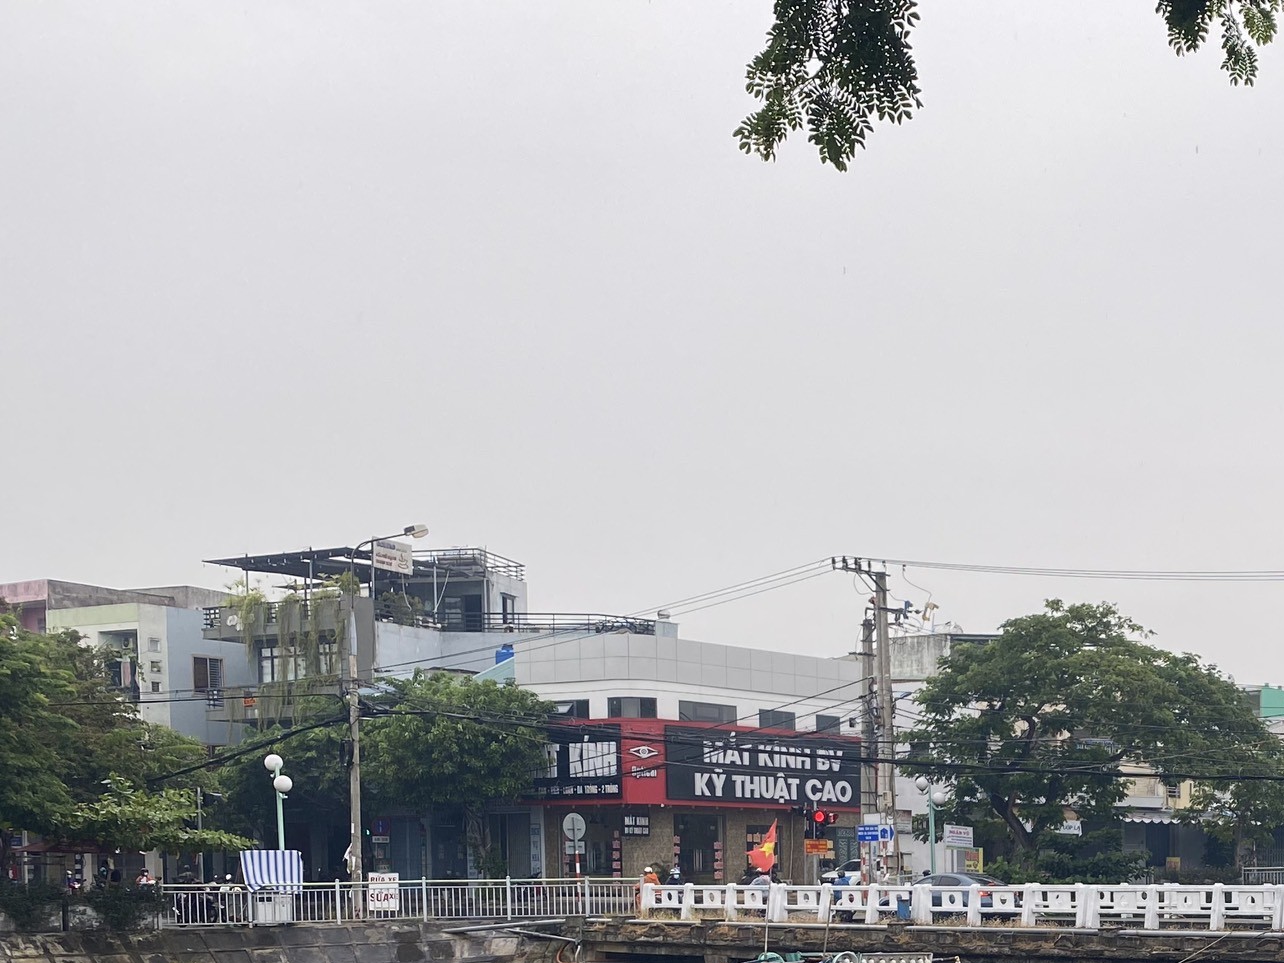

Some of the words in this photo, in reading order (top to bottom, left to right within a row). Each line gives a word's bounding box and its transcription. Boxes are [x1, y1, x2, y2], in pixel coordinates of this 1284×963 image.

[569, 735, 618, 778] KÍNH
[703, 731, 752, 766] MẮT
[758, 740, 811, 770] KÍNH
[816, 749, 844, 772] BV
[694, 768, 727, 797] KỸ
[732, 772, 800, 804] THUẬT
[805, 779, 853, 803] CAO
